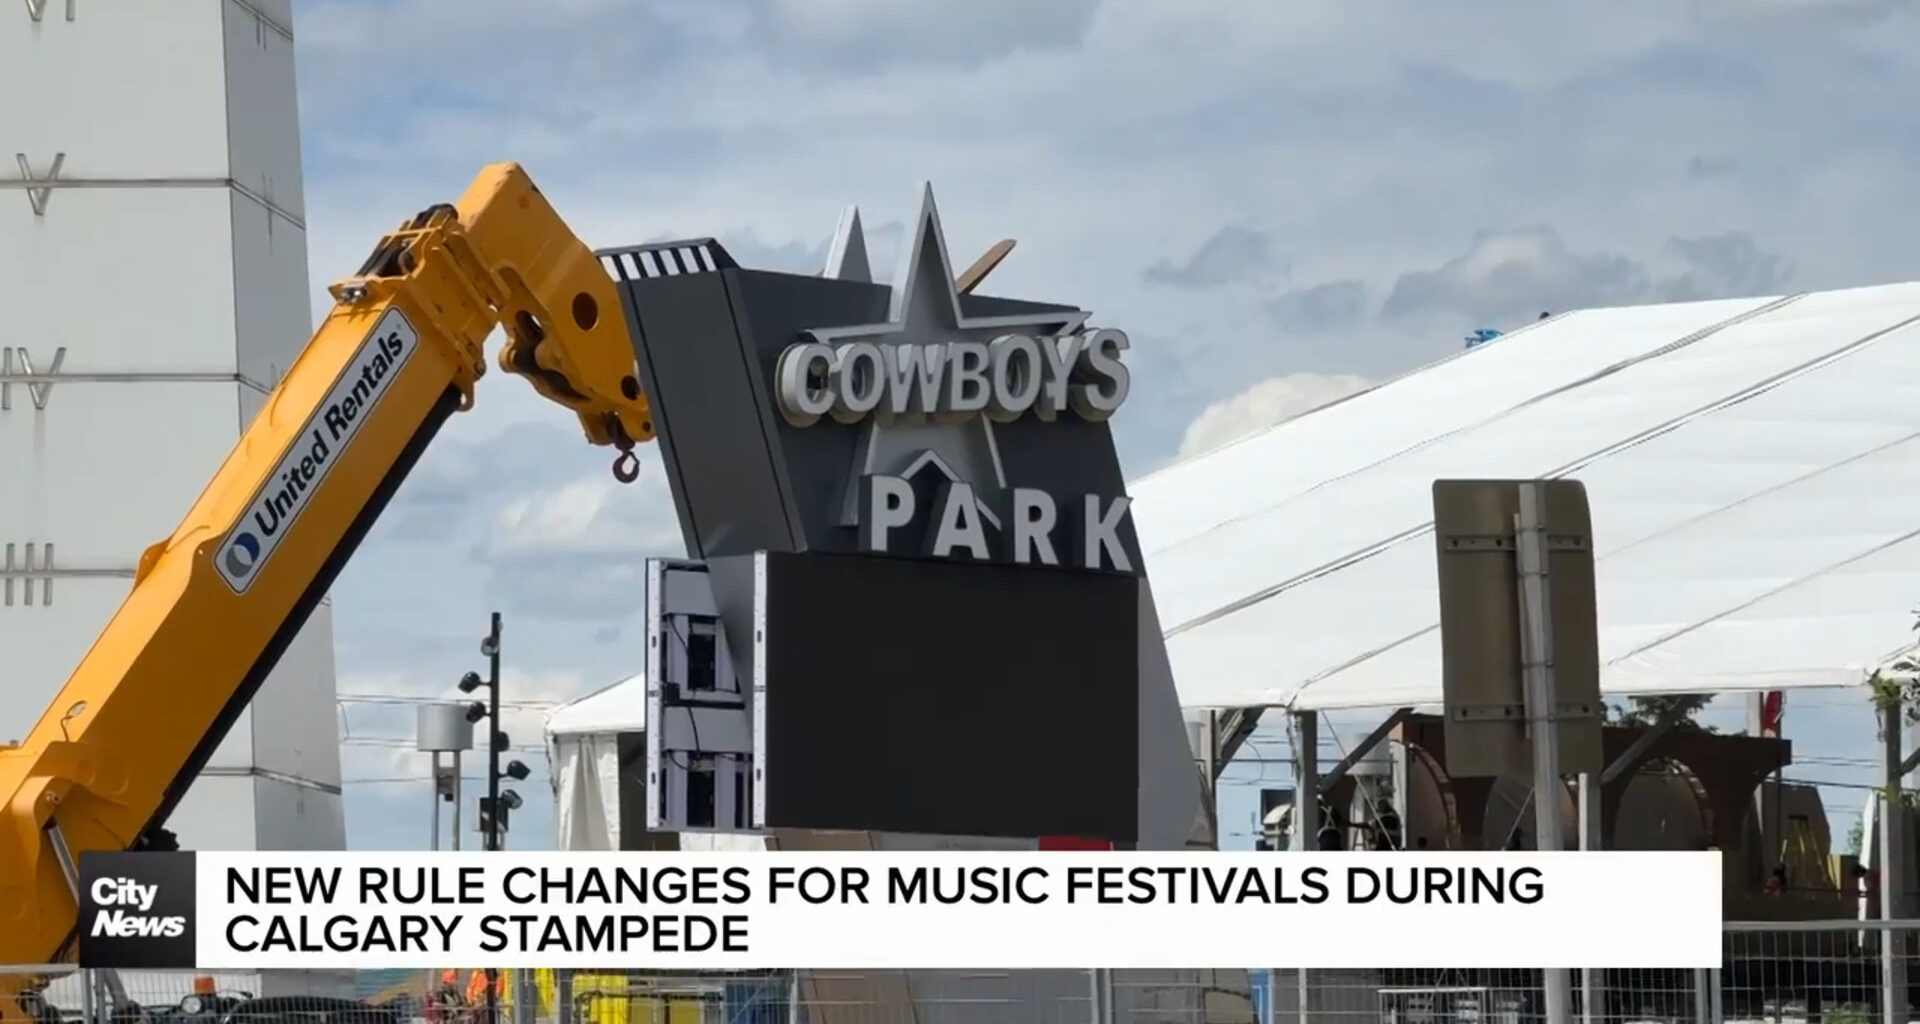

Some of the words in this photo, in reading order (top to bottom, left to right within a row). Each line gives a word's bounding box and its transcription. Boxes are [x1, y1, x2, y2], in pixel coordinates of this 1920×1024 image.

[783, 328, 1131, 416] COWBOYS
[253, 429, 331, 538] United
[323, 330, 404, 441] Rentals
[868, 474, 1134, 572] PARK
